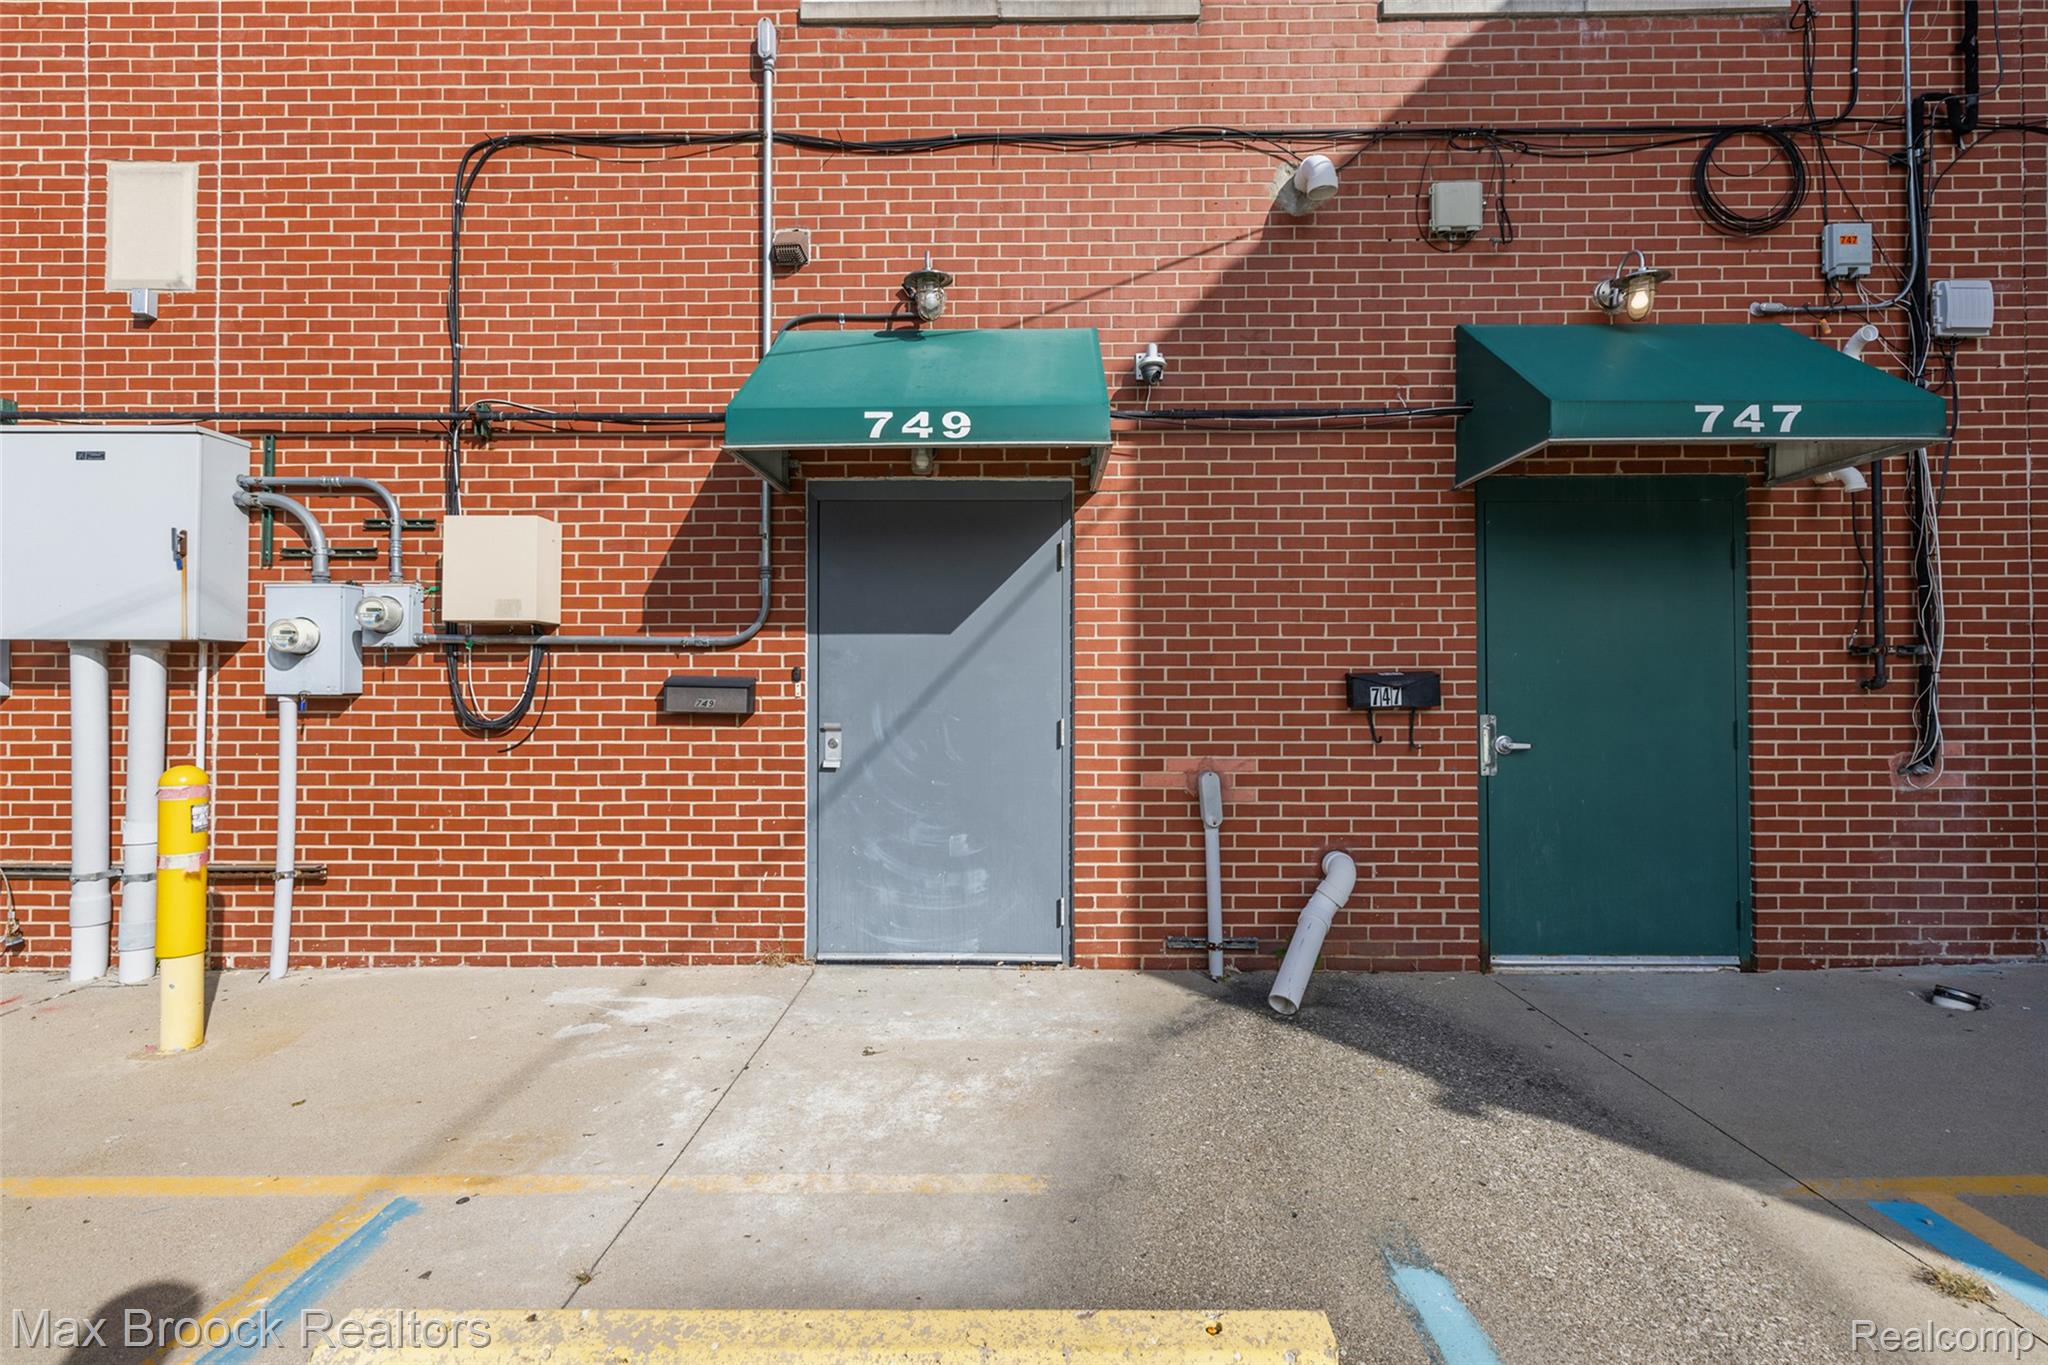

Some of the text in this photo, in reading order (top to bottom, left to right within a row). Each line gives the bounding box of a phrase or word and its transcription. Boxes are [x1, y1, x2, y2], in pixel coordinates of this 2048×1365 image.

[1840, 235, 1857, 245] 747
[863, 411, 972, 439] 749
[1694, 404, 1802, 433] 747
[695, 699, 715, 708] 749
[1371, 687, 1401, 706] 747
